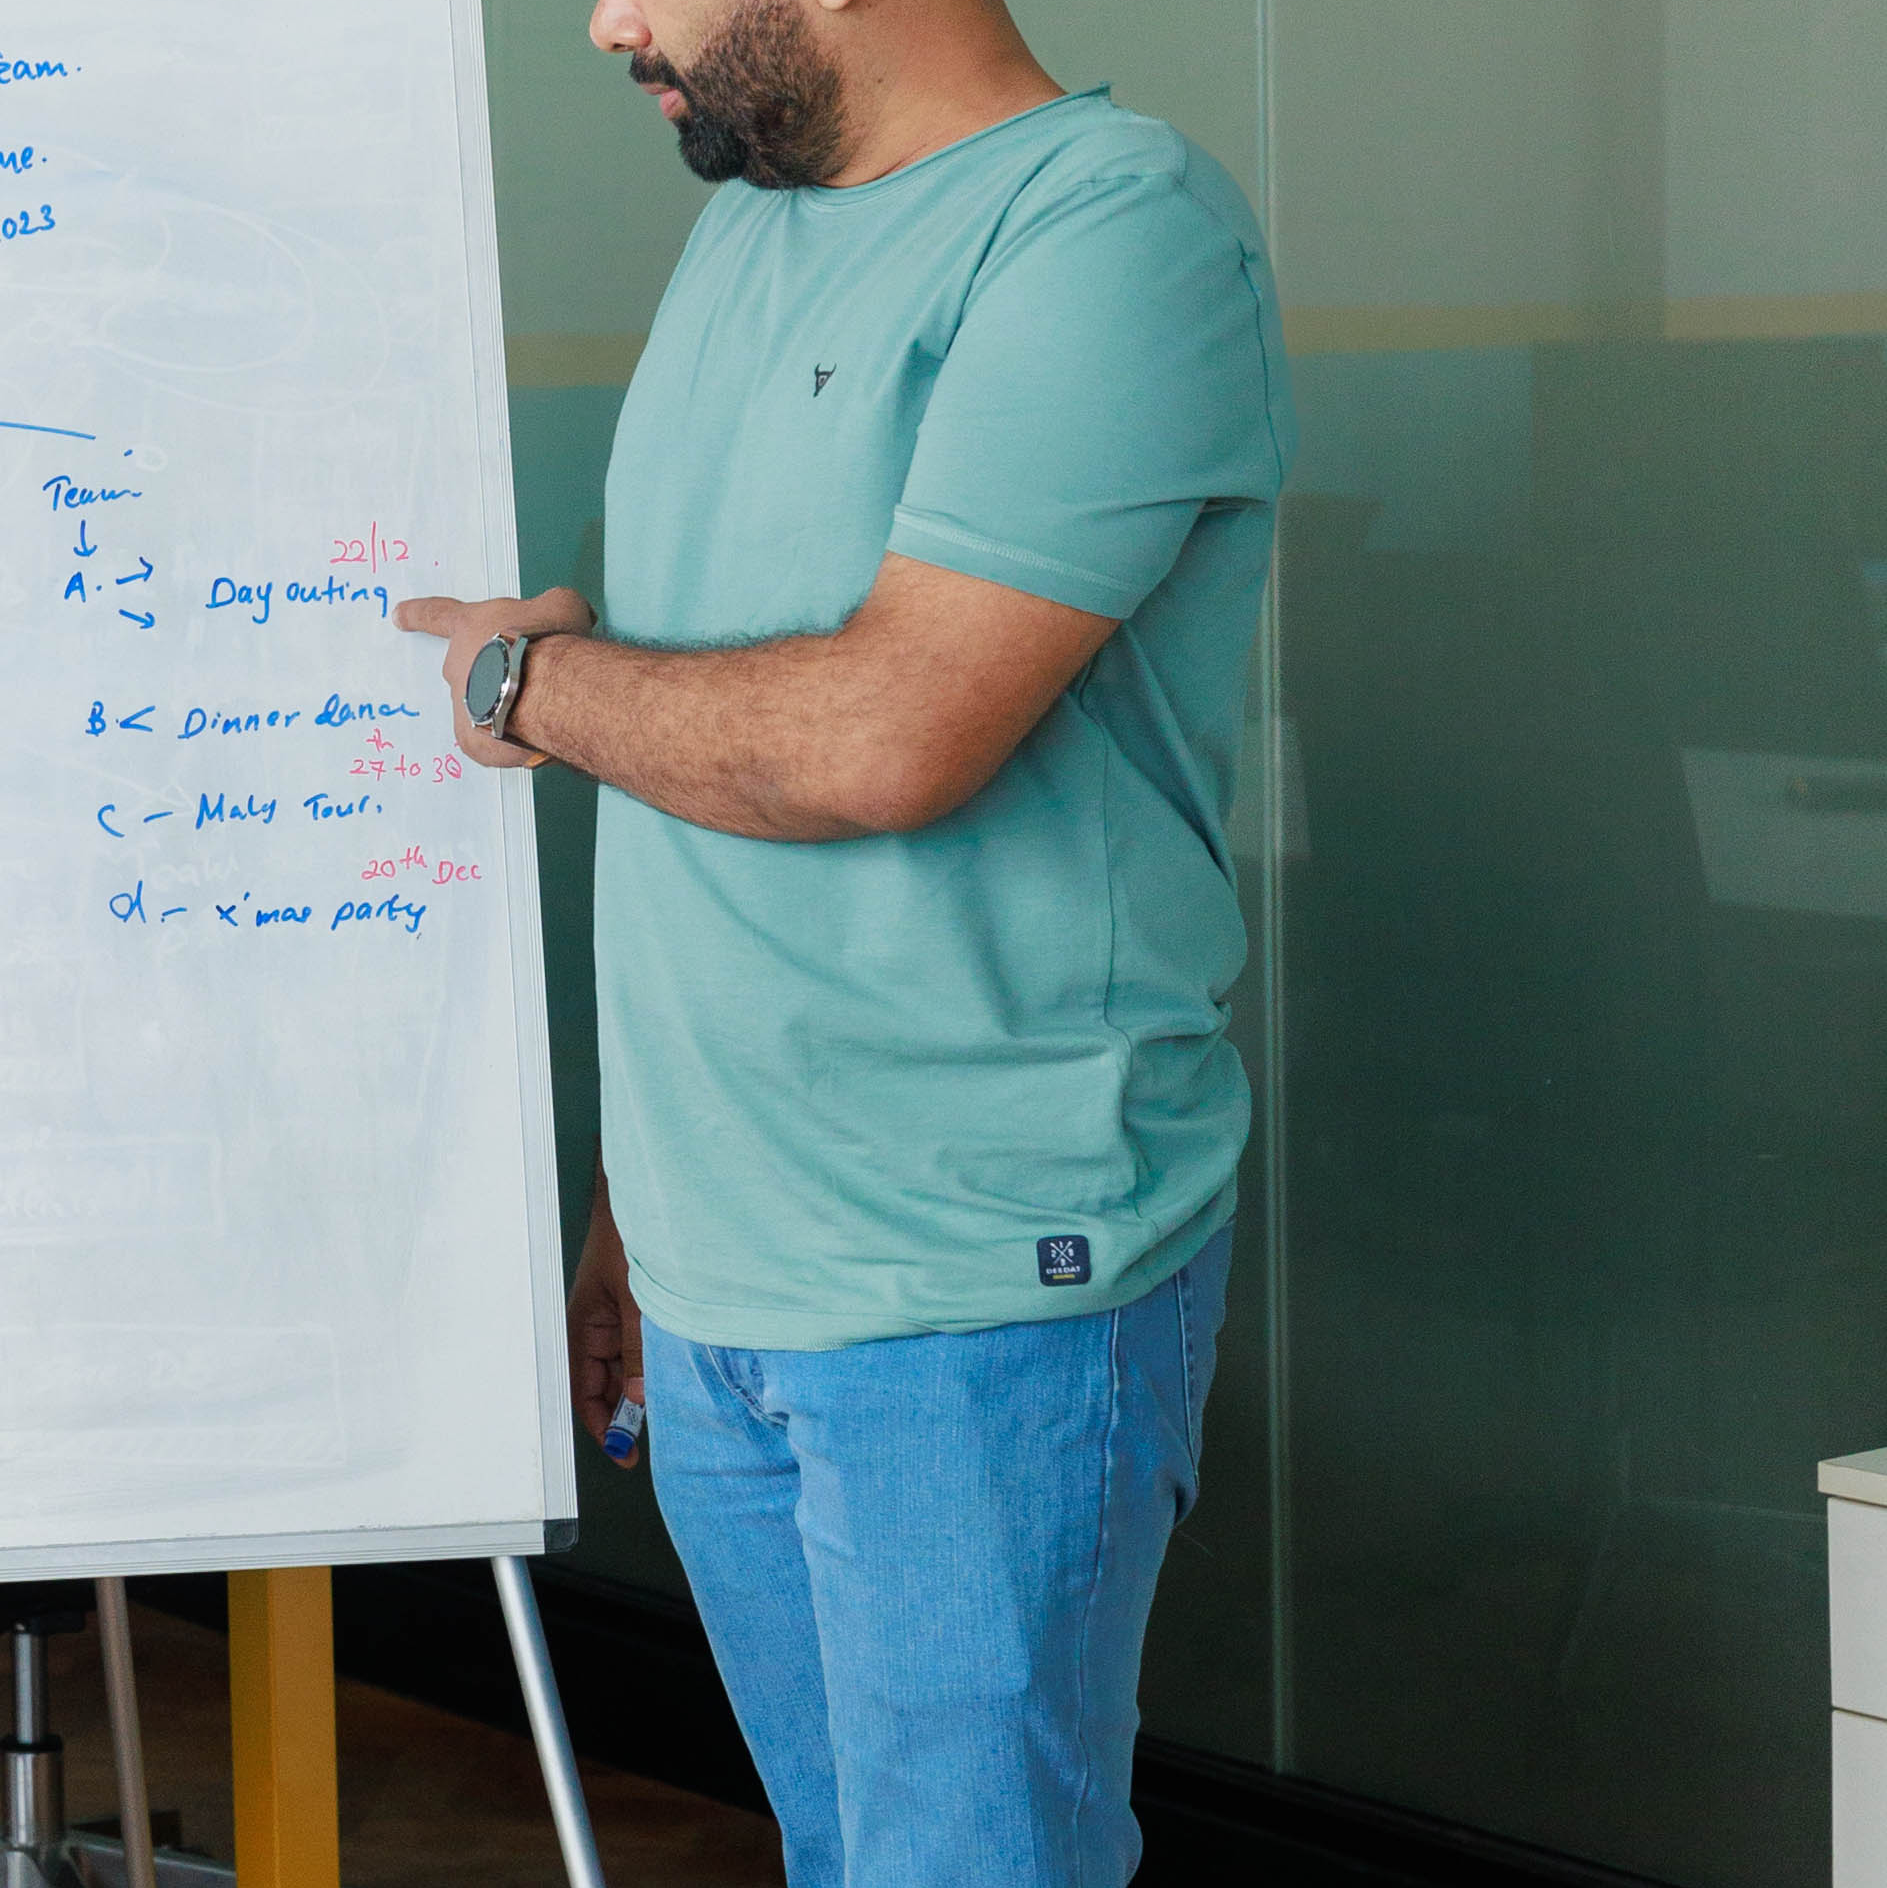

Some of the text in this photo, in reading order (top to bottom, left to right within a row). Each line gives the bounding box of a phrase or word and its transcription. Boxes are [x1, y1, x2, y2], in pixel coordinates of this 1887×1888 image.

[330, 521, 409, 573] 22/12
[205, 576, 388, 624] Day outing
[178, 708, 300, 739] Dinner
[394, 754, 422, 778] to
[432, 860, 482, 884] Dec
[331, 894, 427, 933] party
